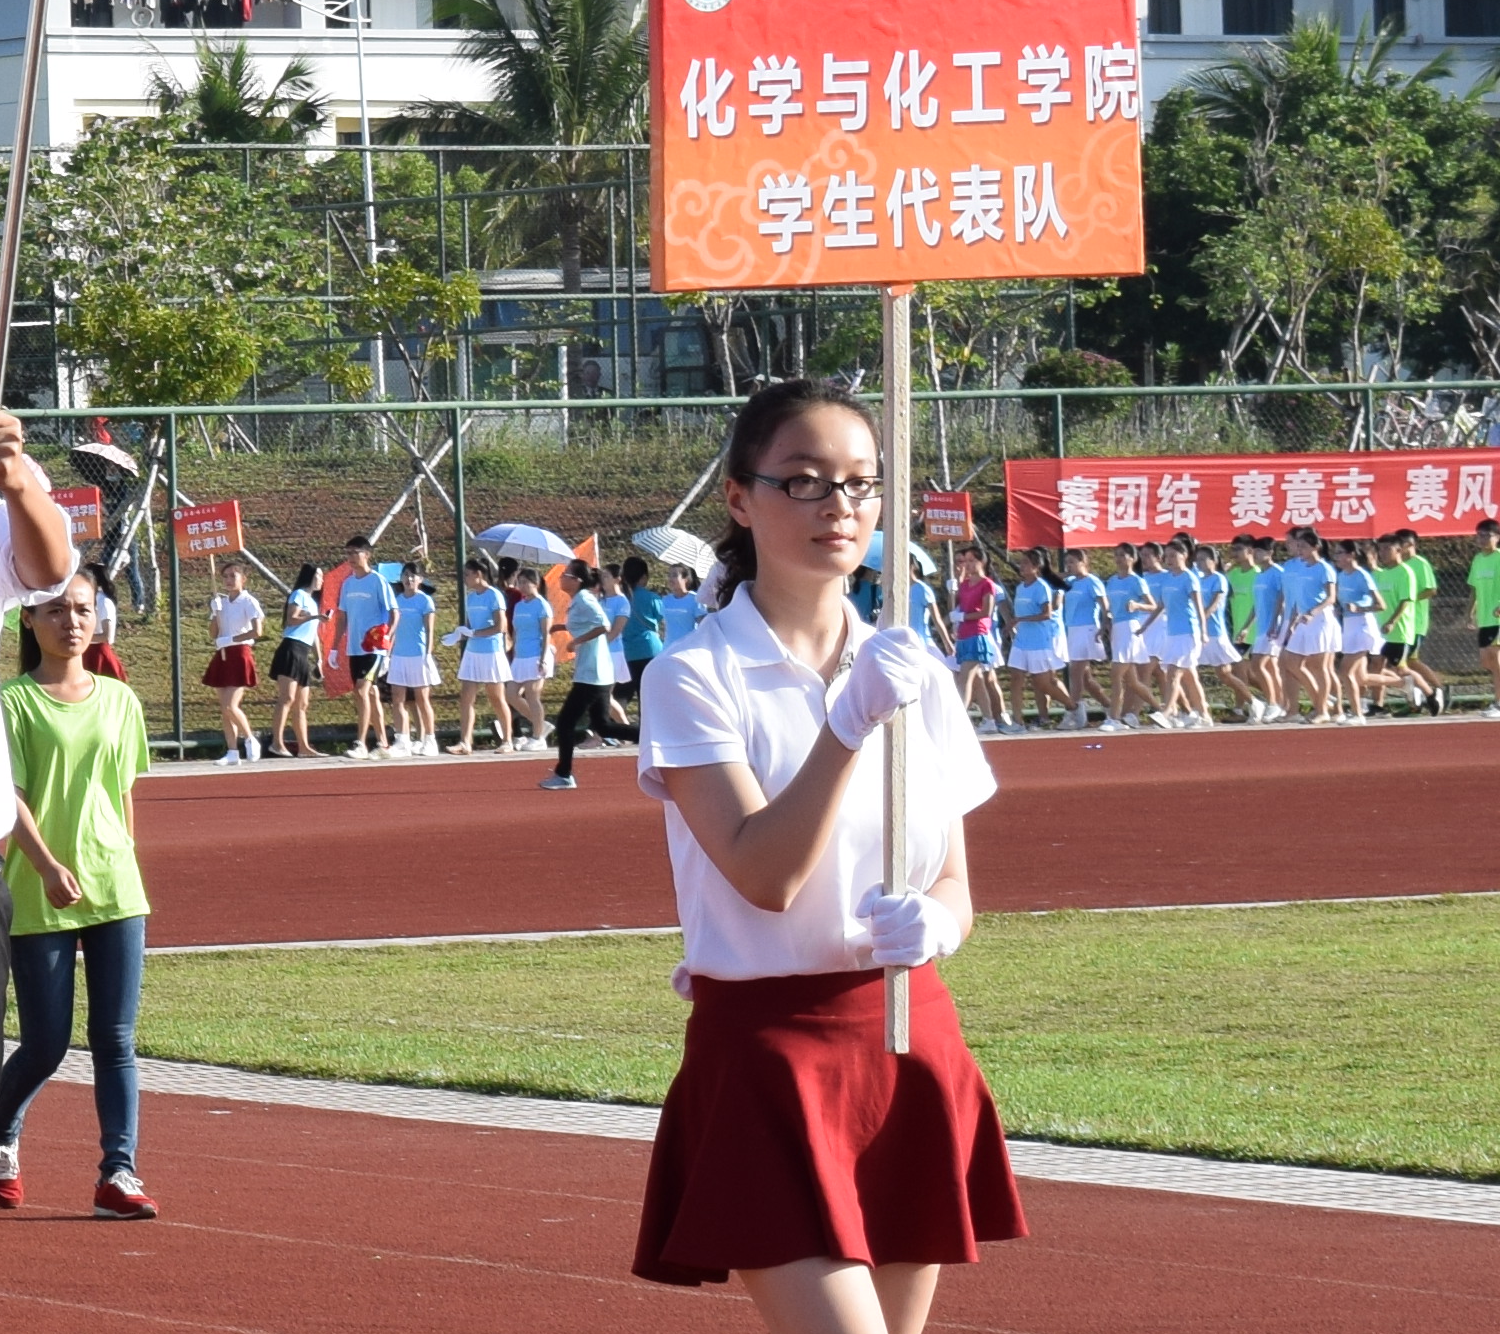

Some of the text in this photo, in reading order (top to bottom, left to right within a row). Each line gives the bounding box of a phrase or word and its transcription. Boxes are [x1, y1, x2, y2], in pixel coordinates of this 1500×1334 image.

[680, 42, 1138, 139] 化学与化工学院
[758, 162, 1068, 254] 学生代表队
[187, 519, 228, 535] 研究生
[1057, 464, 1498, 532] 赛团结 赛意志 赛风
[190, 535, 229, 552] 代表队
